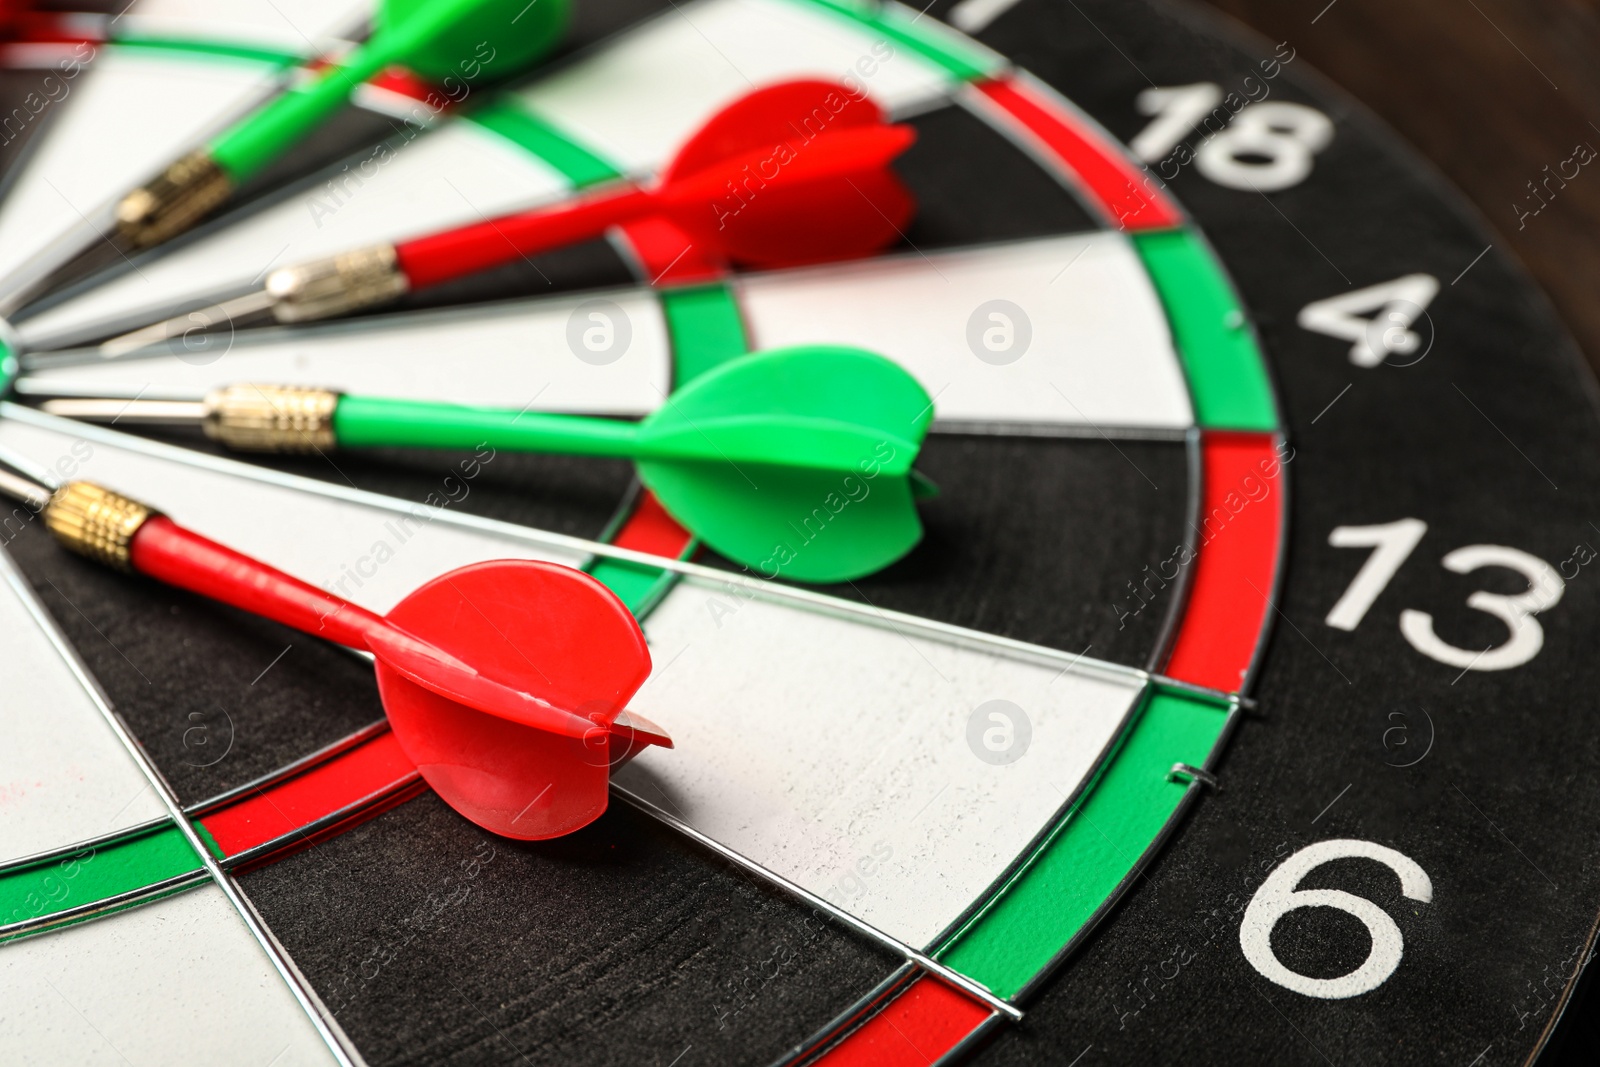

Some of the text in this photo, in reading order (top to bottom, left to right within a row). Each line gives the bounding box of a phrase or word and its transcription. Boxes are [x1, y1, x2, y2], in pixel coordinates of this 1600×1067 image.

[1130, 82, 1335, 192] 18
[1299, 274, 1440, 367] 4
[1325, 518, 1566, 671] 13
[1239, 838, 1433, 1000] 6
